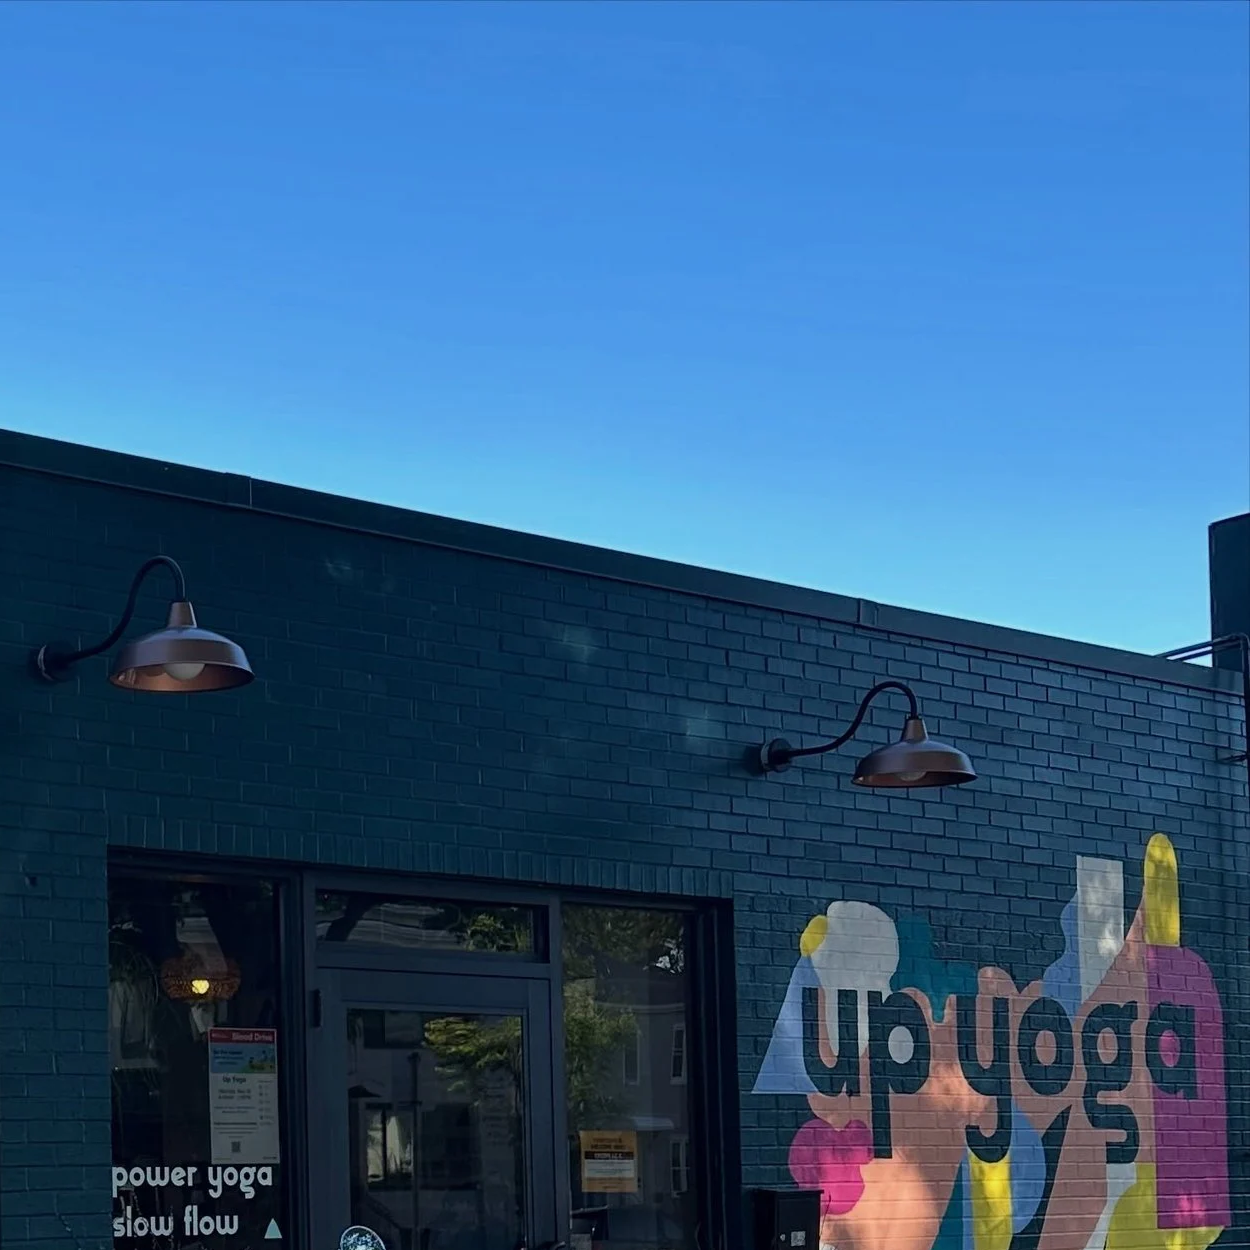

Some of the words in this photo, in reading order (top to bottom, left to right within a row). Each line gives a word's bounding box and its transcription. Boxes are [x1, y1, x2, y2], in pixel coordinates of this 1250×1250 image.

[254, 1032, 273, 1041] Drive
[802, 987, 931, 1159] up
[956, 994, 1196, 1164] yoga
[112, 1165, 196, 1198] power
[208, 1165, 273, 1199] yoga
[113, 1205, 174, 1238] slow
[184, 1205, 239, 1236] flow
